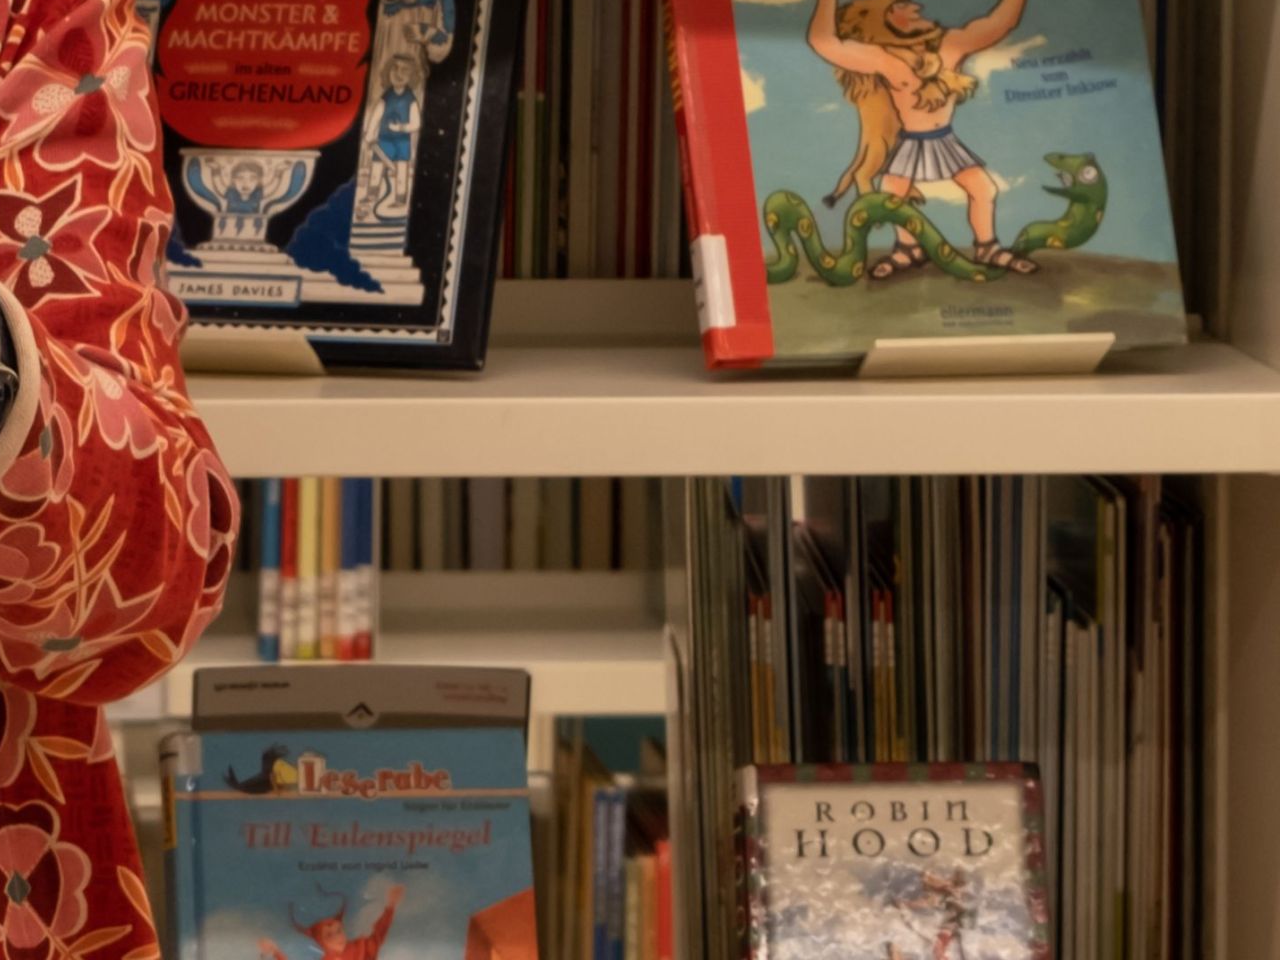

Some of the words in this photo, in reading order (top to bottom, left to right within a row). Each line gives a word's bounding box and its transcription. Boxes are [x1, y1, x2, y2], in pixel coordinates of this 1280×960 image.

[195, 2, 317, 25] MONSTER
[321, 3, 340, 25] &
[167, 26, 361, 54] MACHTKÄMPFE
[234, 62, 253, 75] im
[255, 62, 291, 75] alten
[169, 81, 353, 105] GRIECHENLAND
[178, 283, 223, 295] JAMES
[232, 285, 283, 297] DAVIES
[302, 759, 451, 799] Leserabe
[814, 799, 970, 823] ROBIN
[243, 821, 291, 849] Till
[308, 819, 493, 854] Eulenspiegel
[793, 828, 994, 859] HOOD
